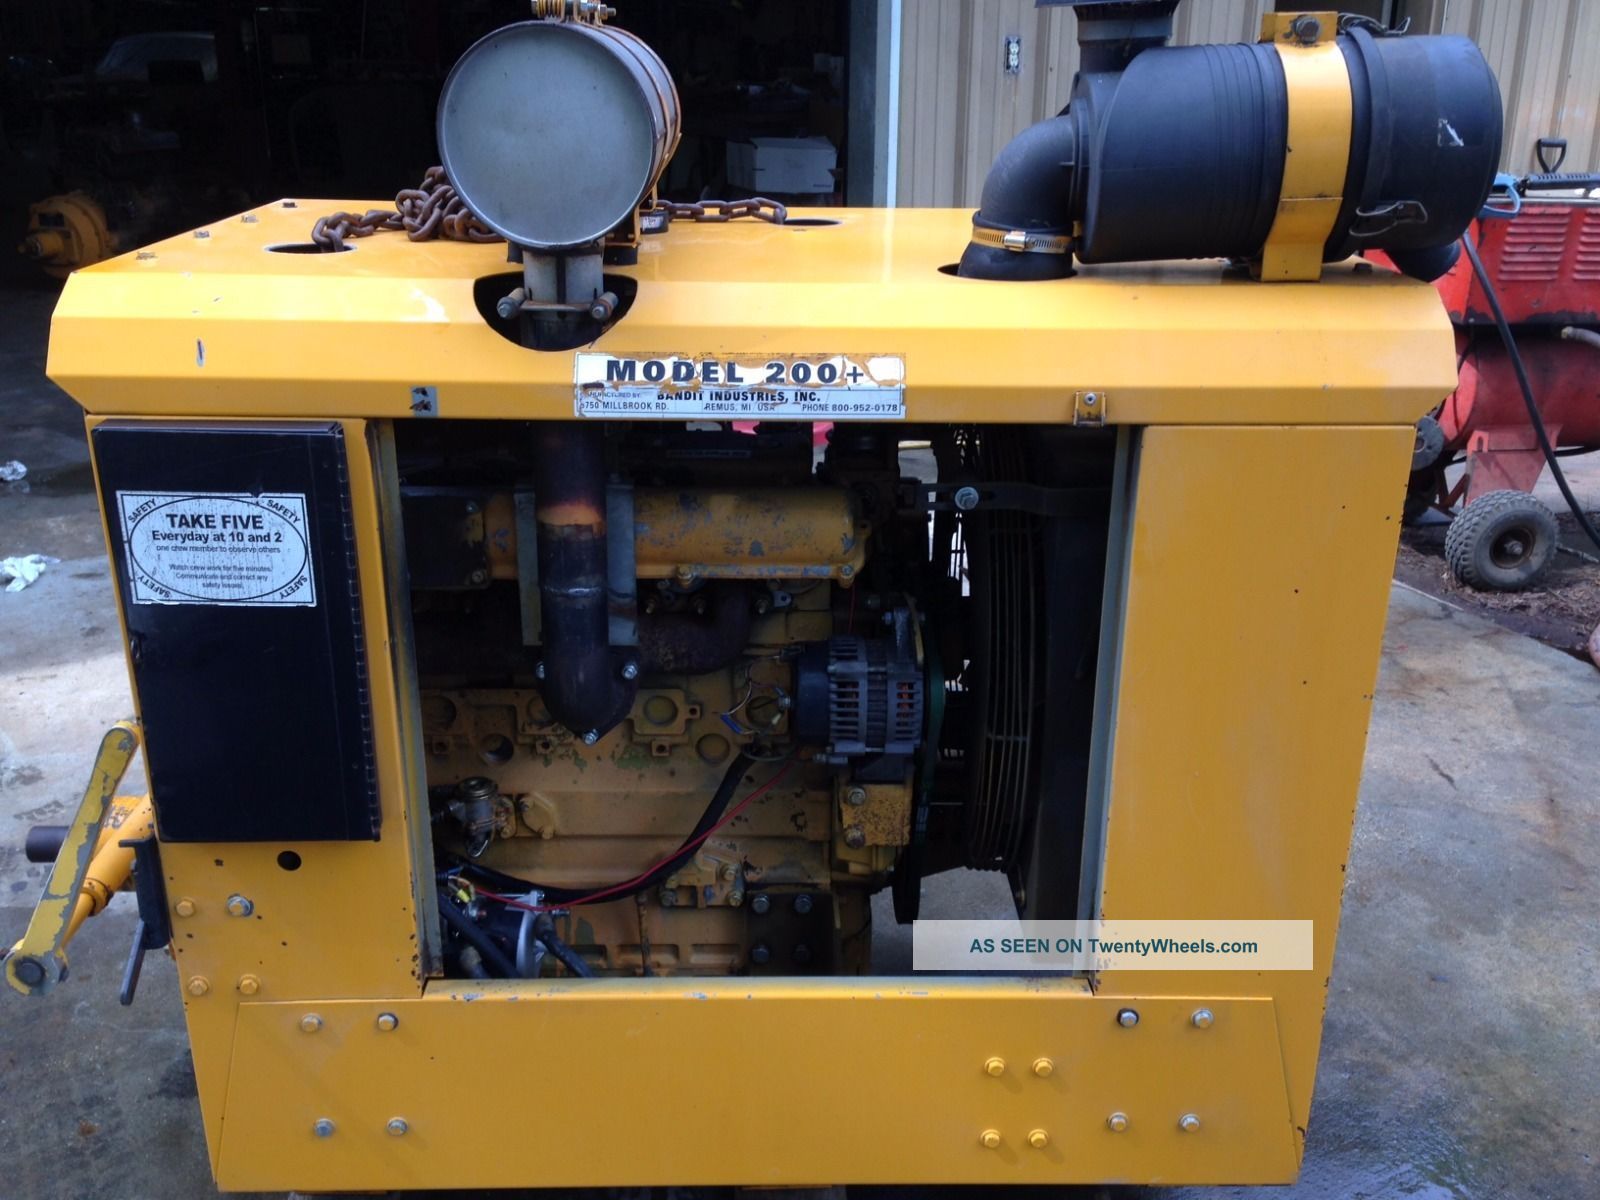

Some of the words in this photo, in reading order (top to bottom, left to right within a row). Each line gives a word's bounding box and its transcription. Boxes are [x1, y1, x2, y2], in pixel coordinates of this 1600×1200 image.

[606, 360, 744, 383] MODEL
[765, 362, 864, 384] 200+
[602, 401, 653, 411] MILLBROOK
[655, 402, 670, 411] RD.
[705, 402, 738, 412] REMUS,
[741, 403, 751, 411] MI
[757, 403, 776, 412] USA
[802, 403, 830, 412] PHONE
[831, 404, 898, 412] 800-952-0178
[657, 390, 704, 401] BANDIT
[710, 390, 789, 403] INDUSTRIES,
[794, 391, 821, 402] INC.
[127, 498, 157, 523] SAFETY
[266, 499, 301, 524] SAFETY
[165, 513, 217, 529] TAKE
[221, 514, 264, 530] FIVE
[151, 530, 209, 544] Everyday
[213, 532, 226, 543] at
[228, 531, 244, 543] 10
[247, 532, 271, 543] and
[274, 531, 282, 543] 2
[169, 563, 189, 571] Watch
[137, 575, 171, 598] SAFETY
[280, 575, 308, 600] SAFETY
